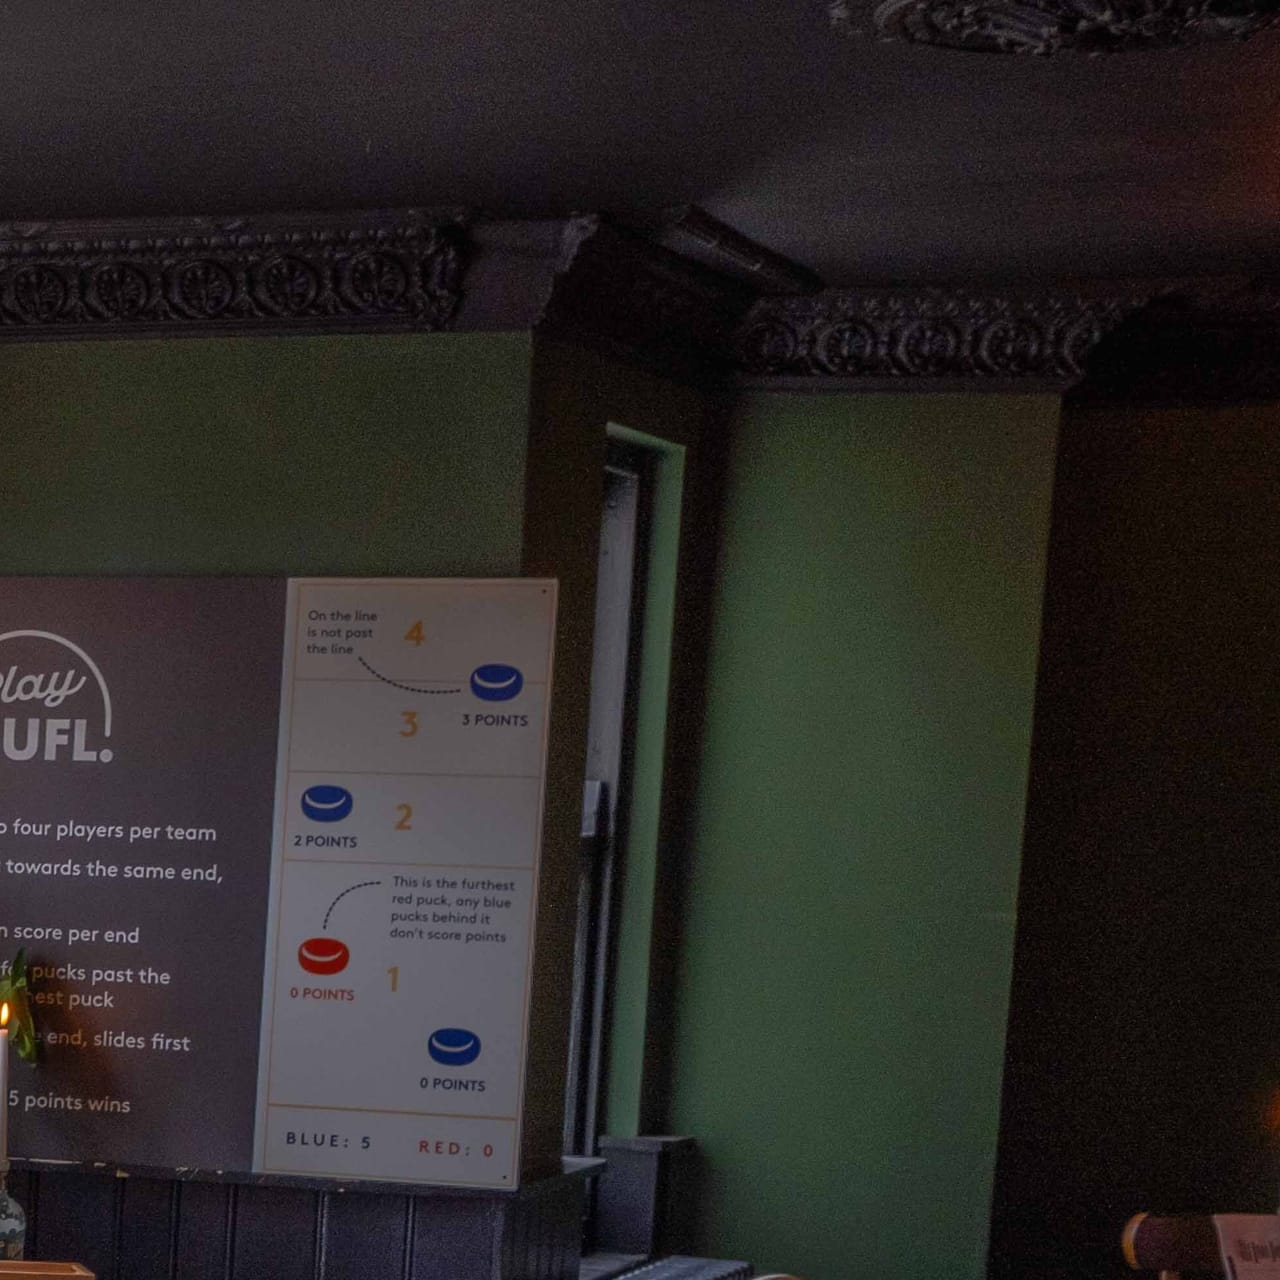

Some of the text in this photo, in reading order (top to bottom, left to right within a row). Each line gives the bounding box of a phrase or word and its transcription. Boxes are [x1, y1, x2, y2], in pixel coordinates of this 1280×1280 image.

[308, 609, 378, 621] On the line
[307, 627, 373, 640] is not past
[405, 622, 425, 645] 4
[306, 644, 354, 654] the line
[400, 711, 418, 737] 3
[462, 714, 529, 727] 3 POINTS
[395, 805, 413, 830] 2
[12, 816, 51, 836] four
[56, 818, 124, 842] players
[129, 823, 161, 843] per
[166, 822, 216, 841] team
[294, 835, 357, 849] 2 POINTS
[5, 858, 81, 877] towards
[86, 860, 118, 878] the
[123, 864, 175, 879] same
[181, 863, 223, 883] end,
[393, 875, 515, 891] This is the furthest
[392, 894, 512, 909] red puck, any blue
[391, 911, 491, 925] pucks behind it
[13, 924, 62, 941] score
[68, 927, 99, 947] per
[103, 926, 139, 944] end
[390, 928, 506, 943] don't score points
[32, 963, 86, 981] pucks
[92, 968, 133, 986] past
[138, 969, 171, 985] the
[387, 966, 399, 992] 1
[69, 992, 114, 1009] puck
[290, 987, 354, 1001] 0 POINTS
[47, 1029, 87, 1048] end,
[93, 1031, 145, 1049] slides
[151, 1033, 191, 1051] first
[420, 1077, 486, 1091] 0 POINTS
[25, 1091, 82, 1111] points
[88, 1096, 130, 1113] wins
[286, 1131, 371, 1149] BLUE: 5
[419, 1139, 493, 1157] RED: 0
